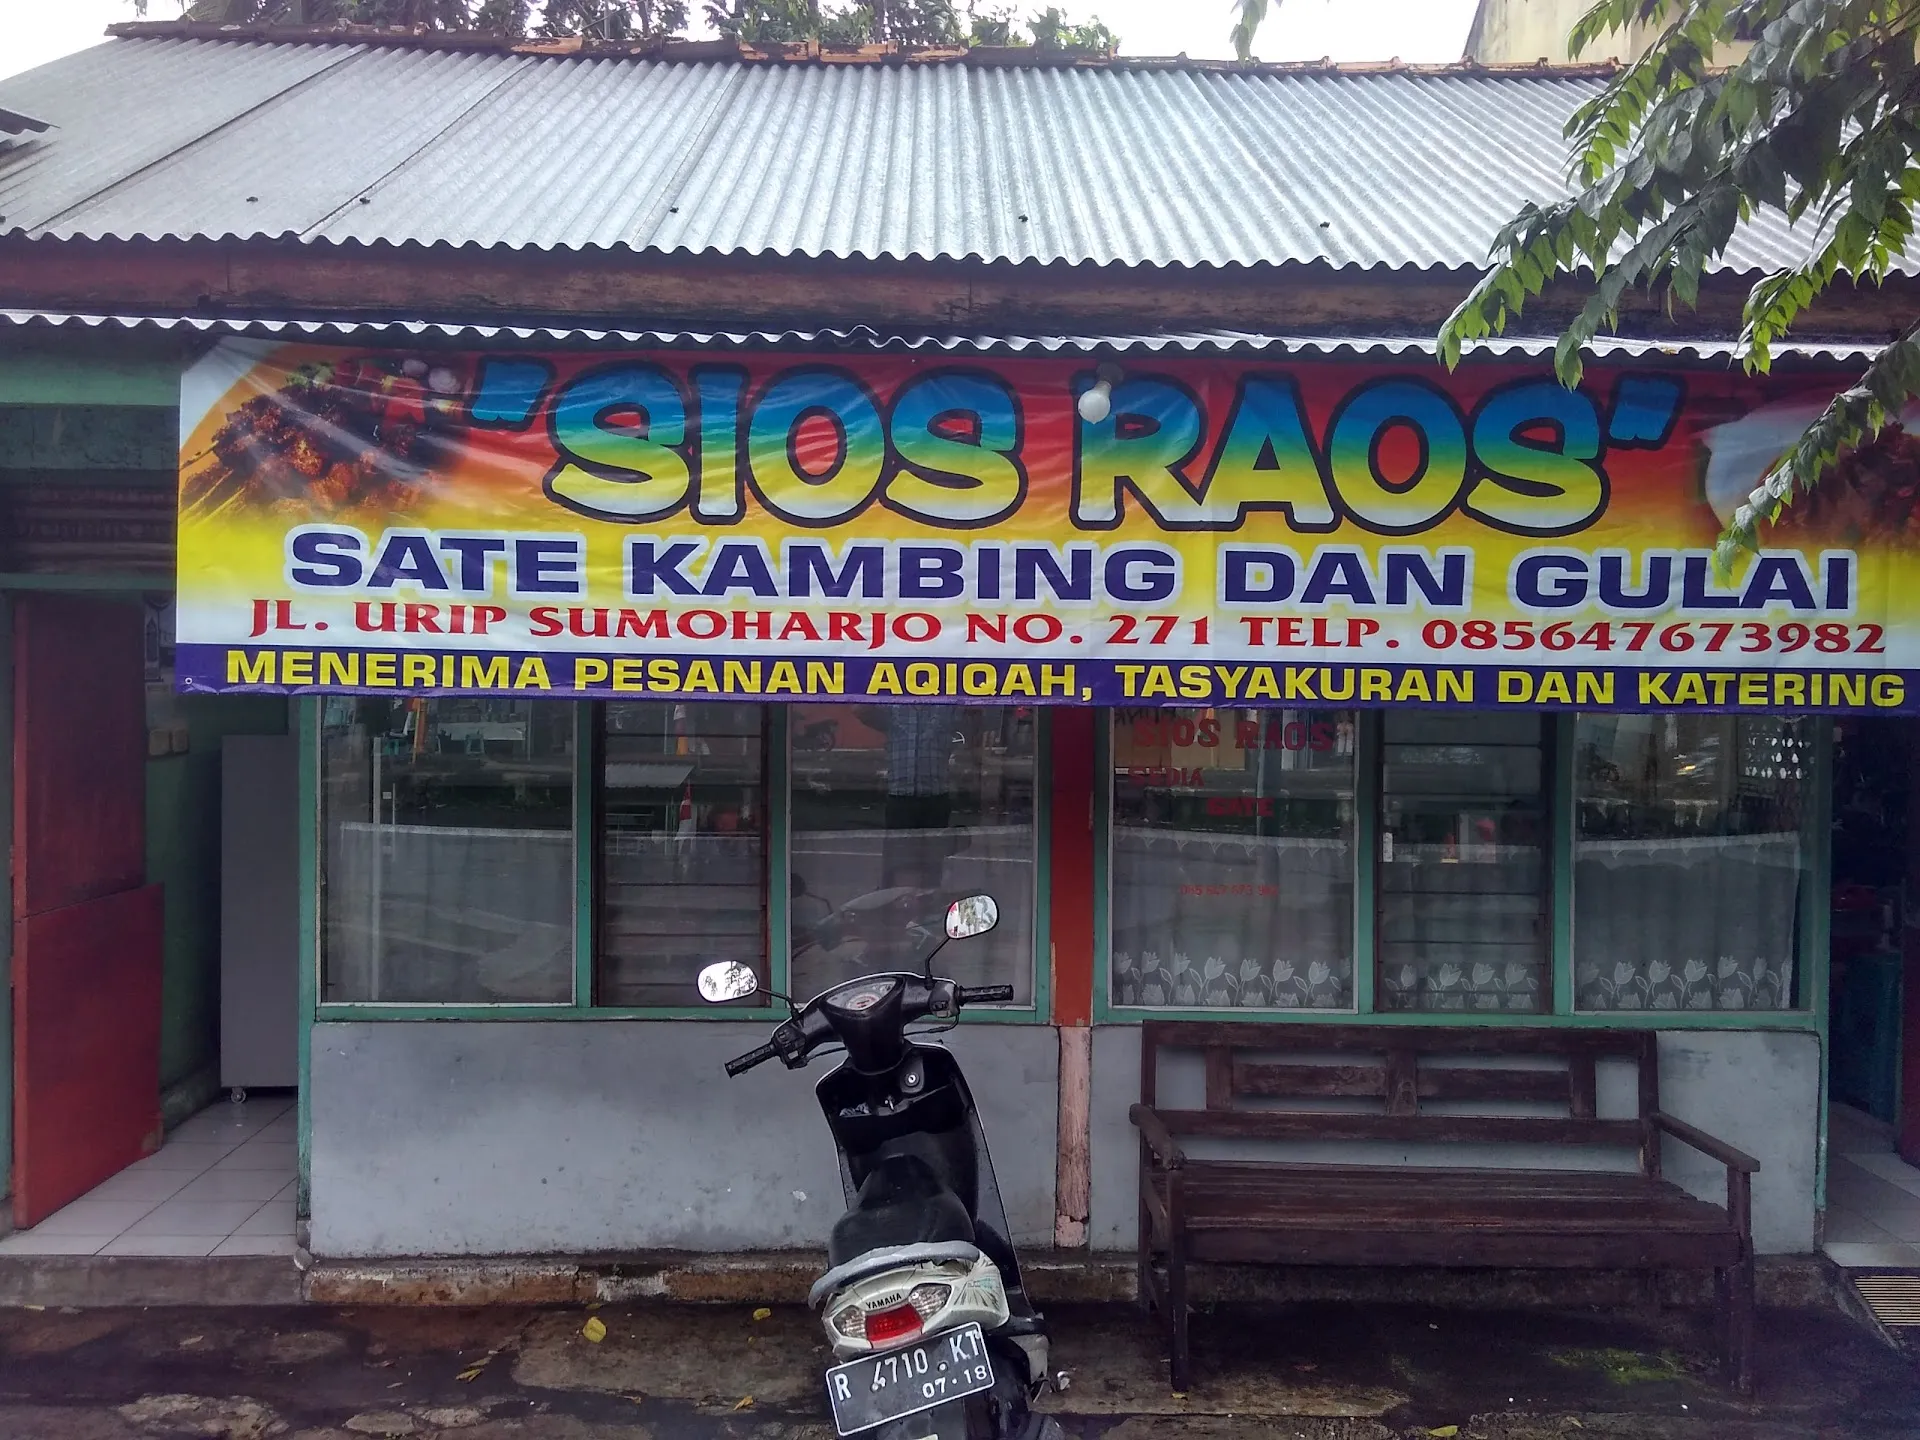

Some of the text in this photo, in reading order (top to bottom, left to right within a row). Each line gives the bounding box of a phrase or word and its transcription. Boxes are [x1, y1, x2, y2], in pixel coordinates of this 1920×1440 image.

[291, 532, 1850, 610] SATE KAMBING DAN GULAI
[248, 599, 1886, 654] JL. URIP SUMOHARJO NO. 271 TELP. 085647673982
[226, 650, 1905, 707] MENERIMA PESANAN AQIQAH, TASYAKURAN DAN KATERING
[1133, 718, 1333, 751] SIOS RAOS
[866, 1293, 903, 1310] YAMAHA
[834, 1329, 982, 1401] R 4710 KT
